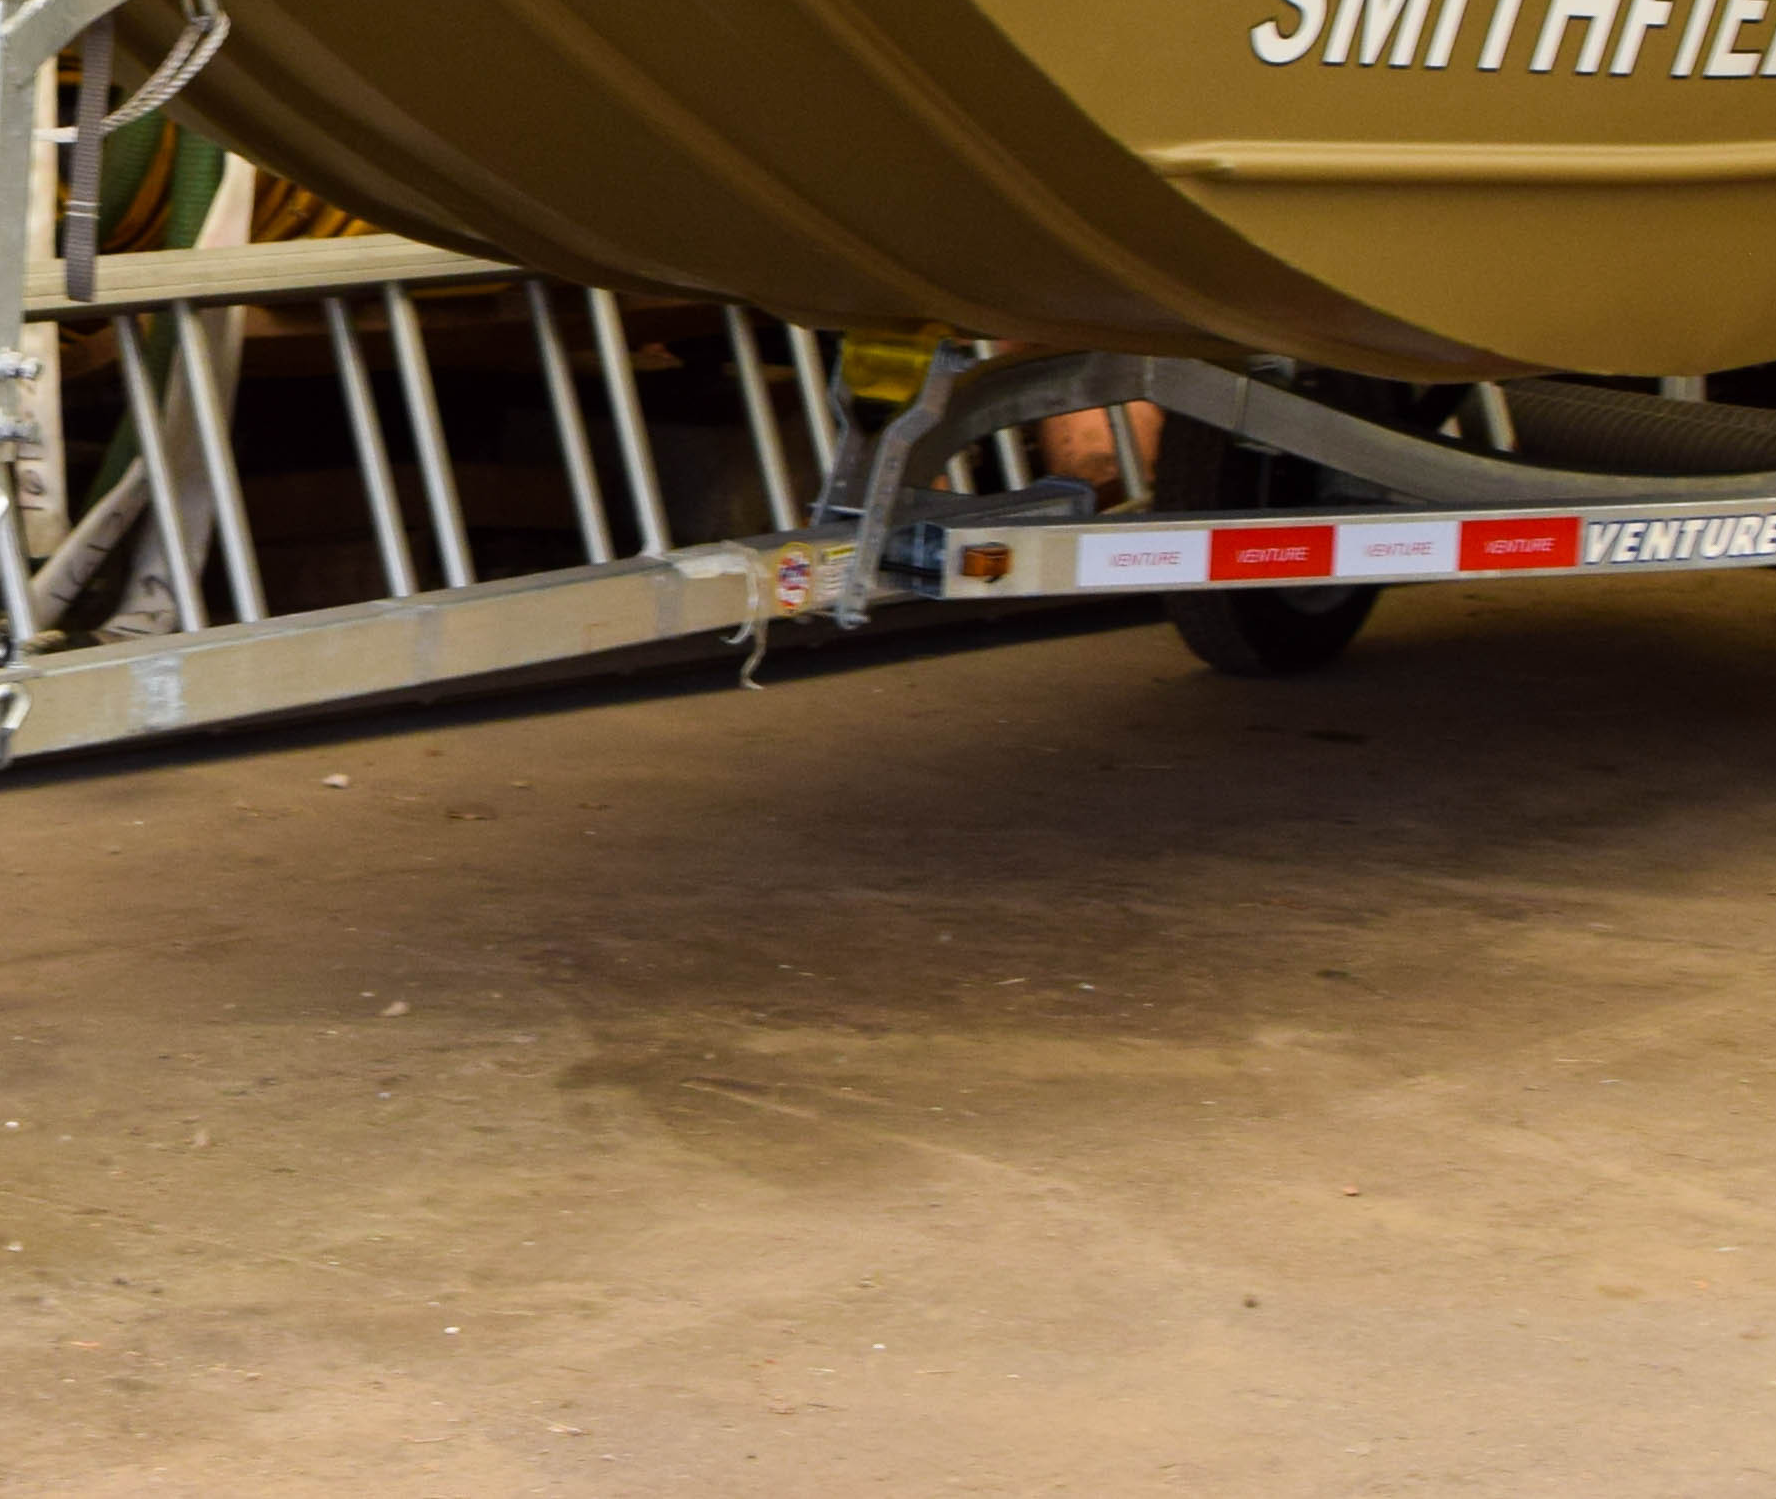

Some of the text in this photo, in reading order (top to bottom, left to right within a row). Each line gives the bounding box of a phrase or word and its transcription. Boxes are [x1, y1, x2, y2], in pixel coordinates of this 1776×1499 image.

[1234, 546, 1312, 565] VENTURE
[1363, 540, 1435, 558] VENTURE
[1482, 537, 1555, 556] VENTURE
[1107, 549, 1183, 569] VENTURE
